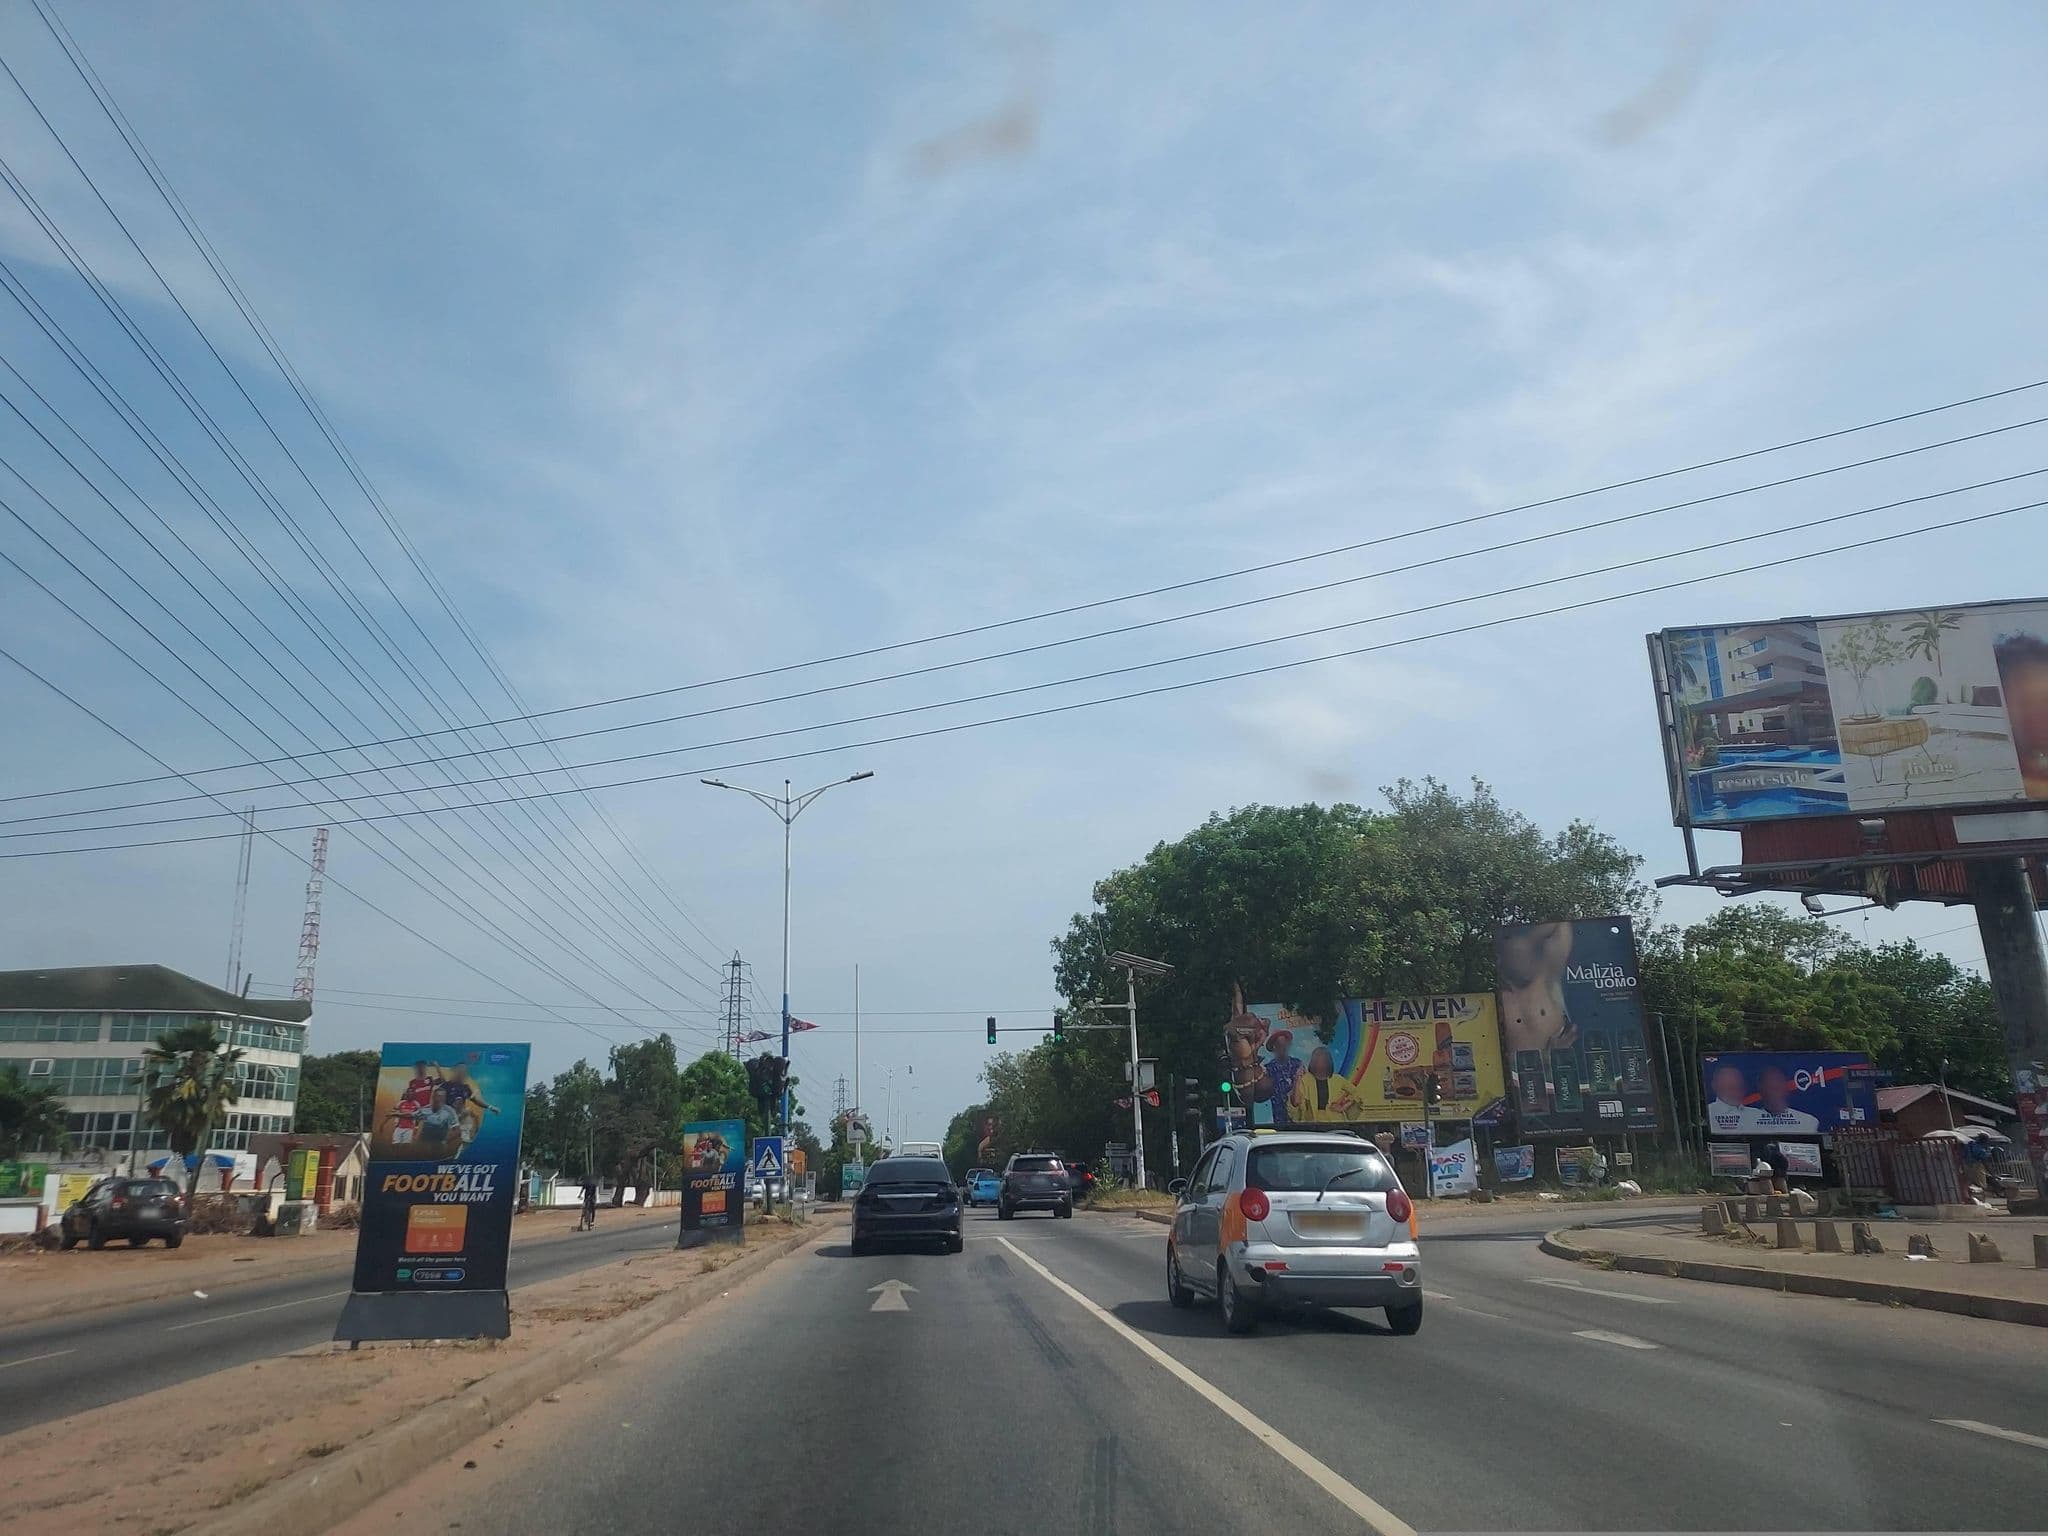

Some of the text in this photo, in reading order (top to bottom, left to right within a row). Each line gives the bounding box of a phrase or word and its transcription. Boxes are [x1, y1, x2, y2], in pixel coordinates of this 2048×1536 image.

[1907, 762, 1954, 775] living
[1567, 963, 1624, 980] Malizia
[1595, 977, 1637, 989] UOMO
[1361, 998, 1466, 1022] HEAVEN
[437, 1164, 499, 1174] WE'VE GOT
[382, 1174, 495, 1192] FOOTBALL
[691, 1176, 736, 1188] FOOTBALL
[433, 1192, 493, 1202] YOU WANT
